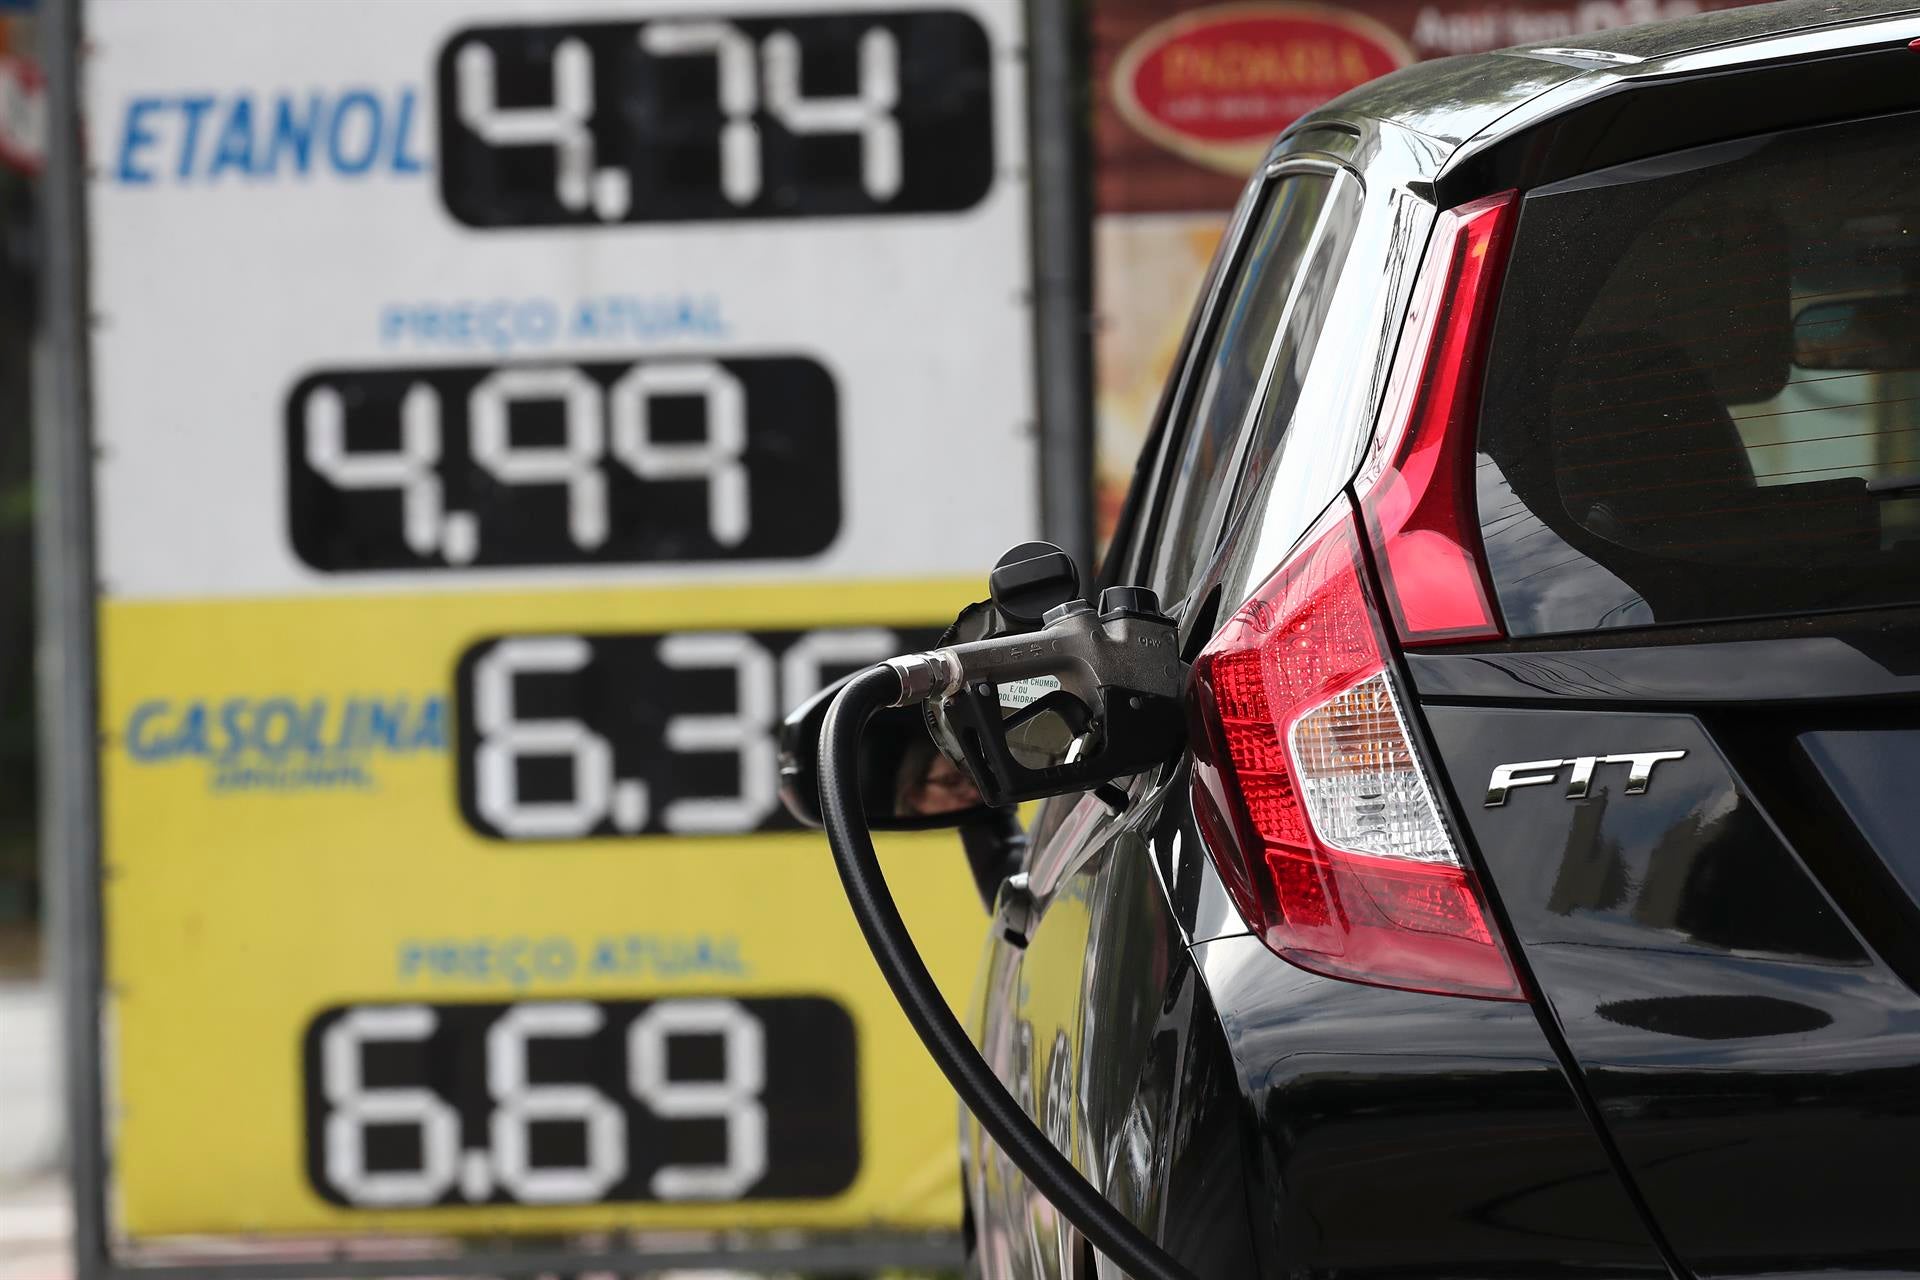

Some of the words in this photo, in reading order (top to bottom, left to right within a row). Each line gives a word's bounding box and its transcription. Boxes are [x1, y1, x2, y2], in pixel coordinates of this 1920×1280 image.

[114, 87, 428, 185] ETANOL
[380, 301, 560, 350] PREÇO
[570, 296, 730, 340] ATUAL
[1012, 694, 1040, 704] HIDRAT
[1030, 678, 1059, 689] CHUMBO
[124, 694, 448, 763] GASOLINA
[1483, 750, 1690, 808] FIT
[398, 938, 582, 990] PREÇO
[588, 934, 750, 979] ATUAL
